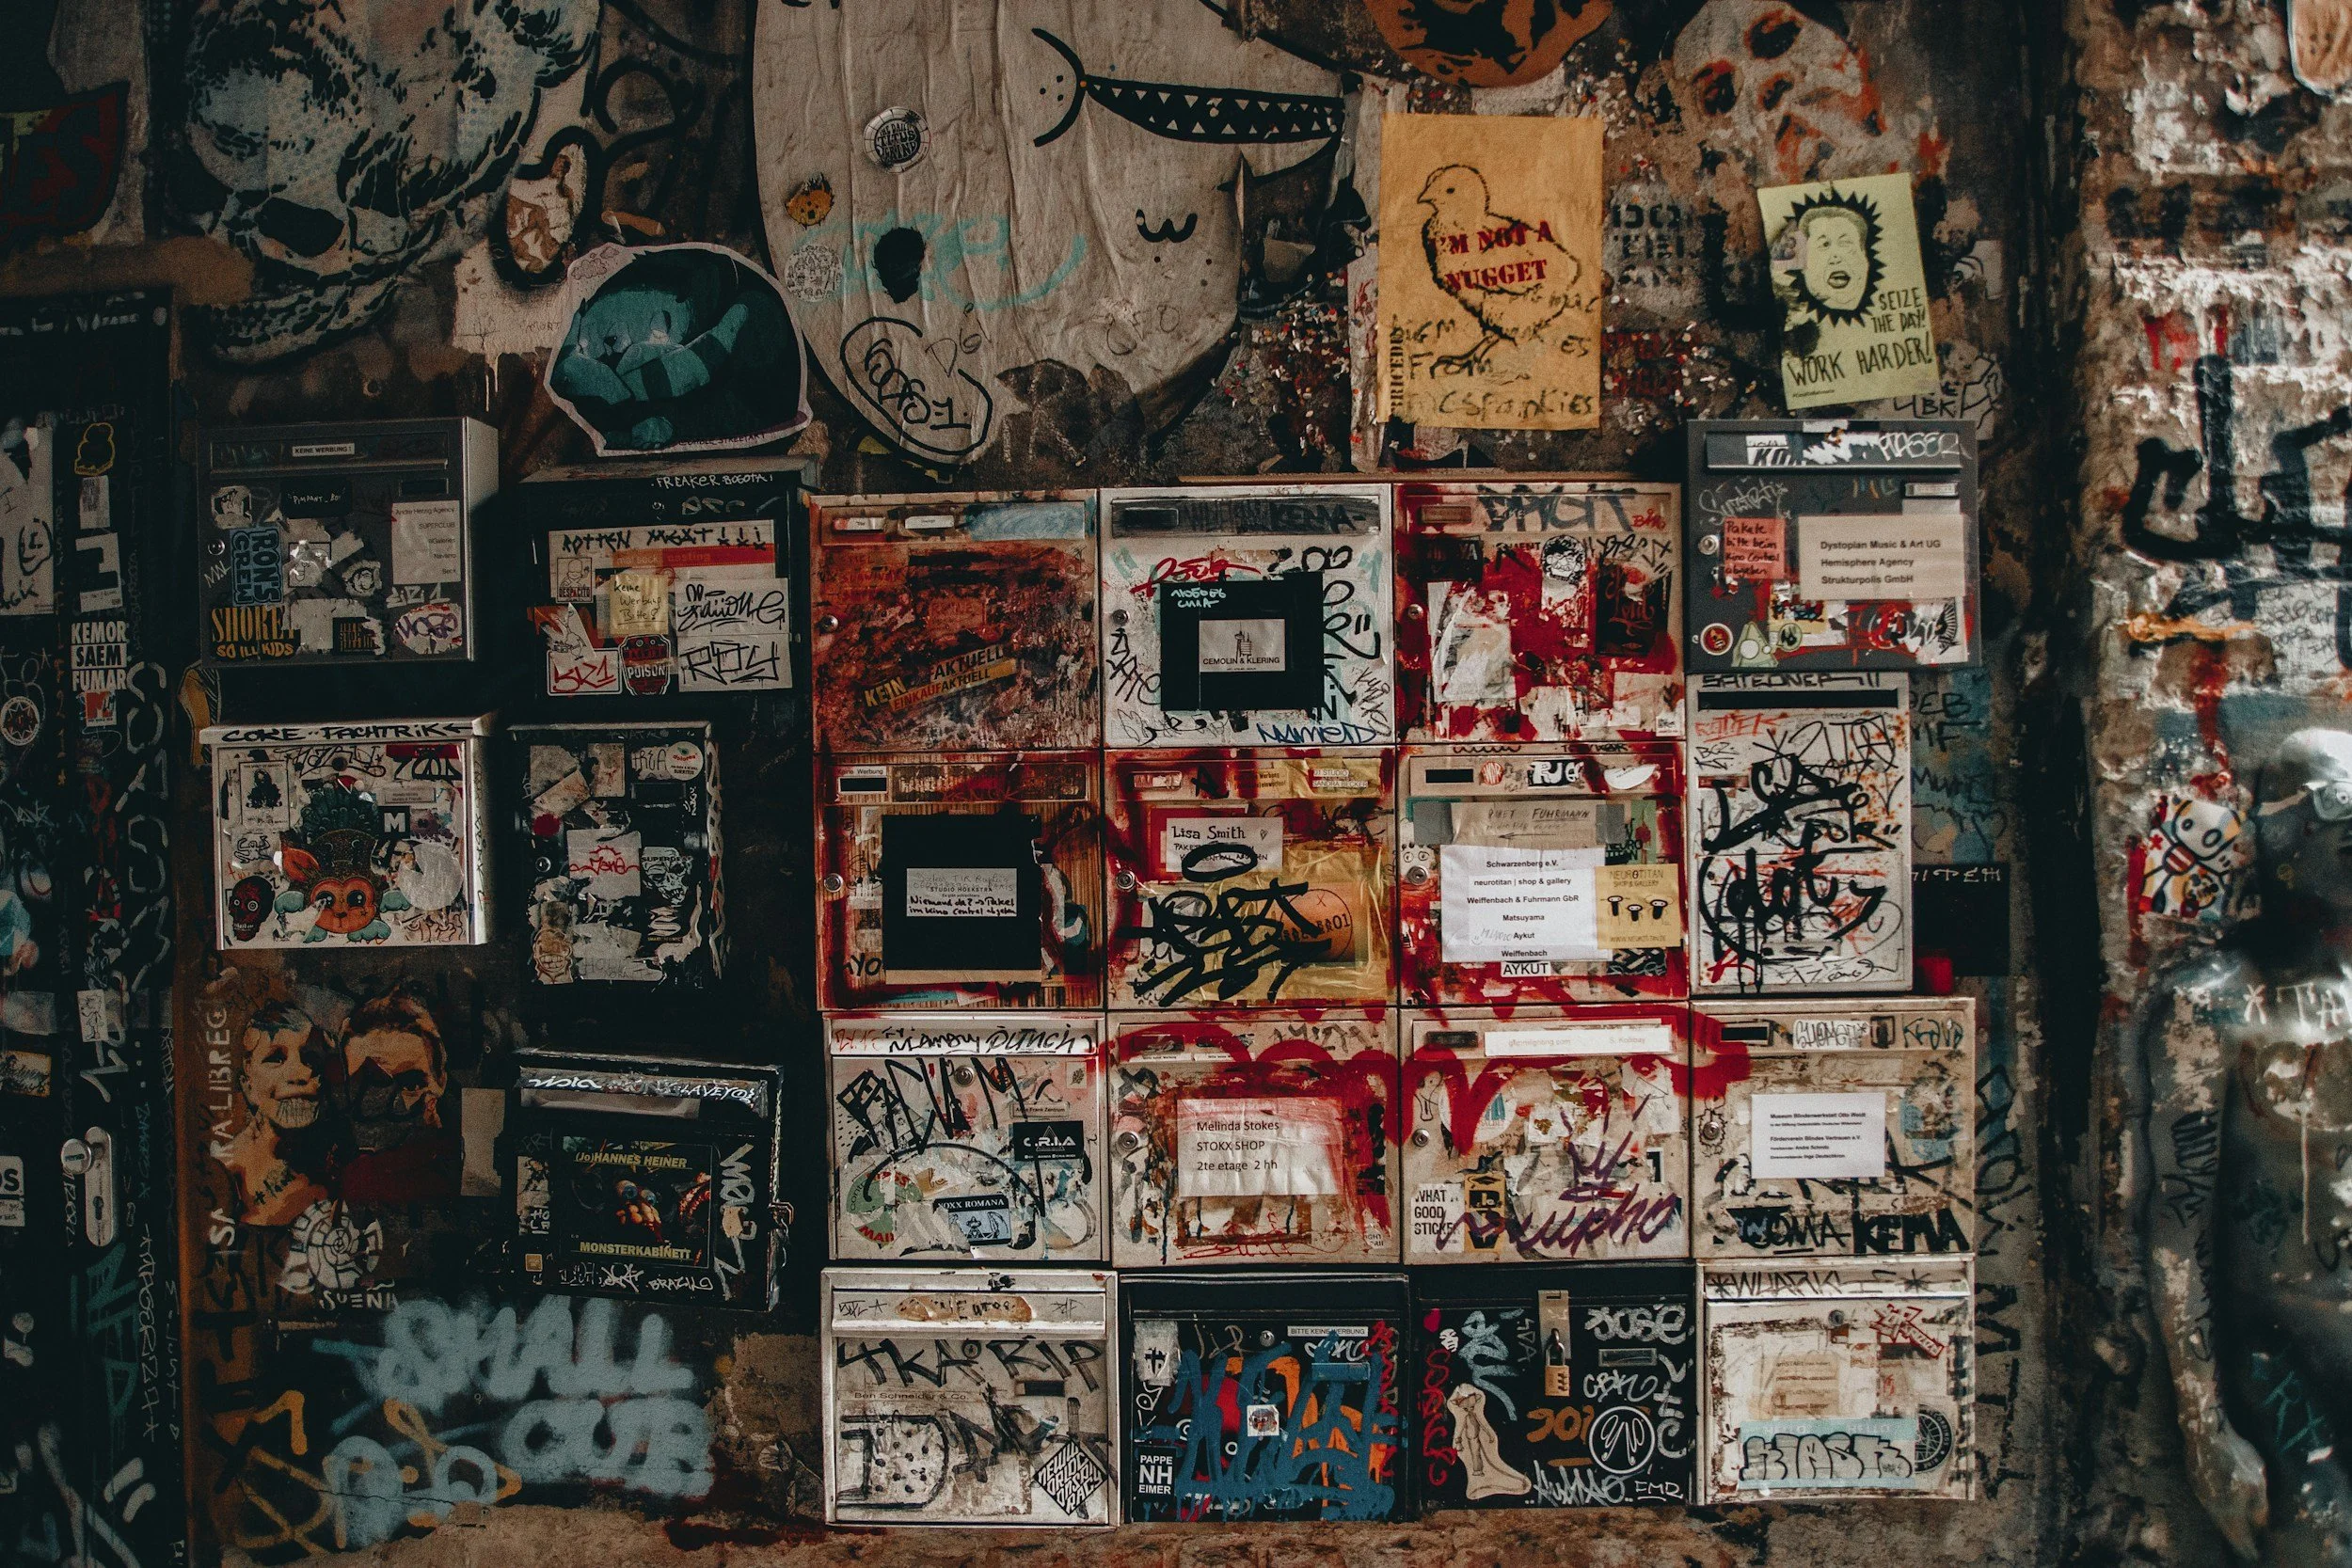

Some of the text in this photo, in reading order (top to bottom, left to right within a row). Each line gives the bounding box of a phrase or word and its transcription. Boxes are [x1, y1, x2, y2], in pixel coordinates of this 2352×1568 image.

[1536, 220, 1554, 244] A
[1444, 259, 1549, 293] NUGGET
[1878, 287, 1922, 311] SEIZE
[1872, 309, 1927, 334] THE DAY!
[1788, 333, 1934, 388] WORK HARDER!
[315, 445, 346, 453] WERBUNG
[1820, 540, 1868, 550] Dystopian
[1869, 540, 1898, 549] Music
[1909, 539, 1925, 548] Art
[1926, 540, 1942, 549] UG
[231, 531, 253, 605] CREW
[1820, 557, 1915, 568] Hemisphere Agency
[1820, 574, 1915, 585] Strukturpolis GmbH
[75, 644, 122, 667] SAEM
[261, 641, 294, 657] KIDS
[1247, 657, 1281, 666] KLERING
[628, 662, 666, 679] POISON
[864, 644, 1005, 708] KEIN AKTUELL
[72, 669, 129, 692] FUMAR
[856, 768, 883, 776] Werbung
[1171, 825, 1246, 840] Lisa Smith
[1486, 860, 1543, 871] Schwarzenberg
[1518, 878, 1537, 888] shop
[1546, 877, 1572, 888] gallery
[910, 895, 953, 906] Niemand
[1467, 895, 1515, 905] Weiffenbach
[1522, 895, 1562, 904] Fuhrmann
[1563, 895, 1580, 903] GbR
[1502, 913, 1546, 924] Matsuyama
[1513, 931, 1535, 941] Aykut
[1501, 949, 1548, 958] Weiffenbach
[1502, 962, 1549, 975] AYKUT
[1197, 1119, 1279, 1132] Melinda Stokes
[1197, 1140, 1265, 1152] STOKX SHOP
[644, 1154, 689, 1169] HEINER
[1197, 1160, 1279, 1174] 2te etage 2 hh
[964, 1197, 1006, 1209] ROMANA
[1413, 1206, 1445, 1219] GOOD
[579, 1241, 692, 1260] MONSTERKABINETT
[853, 1391, 876, 1400] Ben
[880, 1391, 935, 1400] Schneider
[1138, 1454, 1173, 1465] PAPPE
[1137, 1465, 1174, 1485] NH
[1137, 1483, 1172, 1495] EIMER
